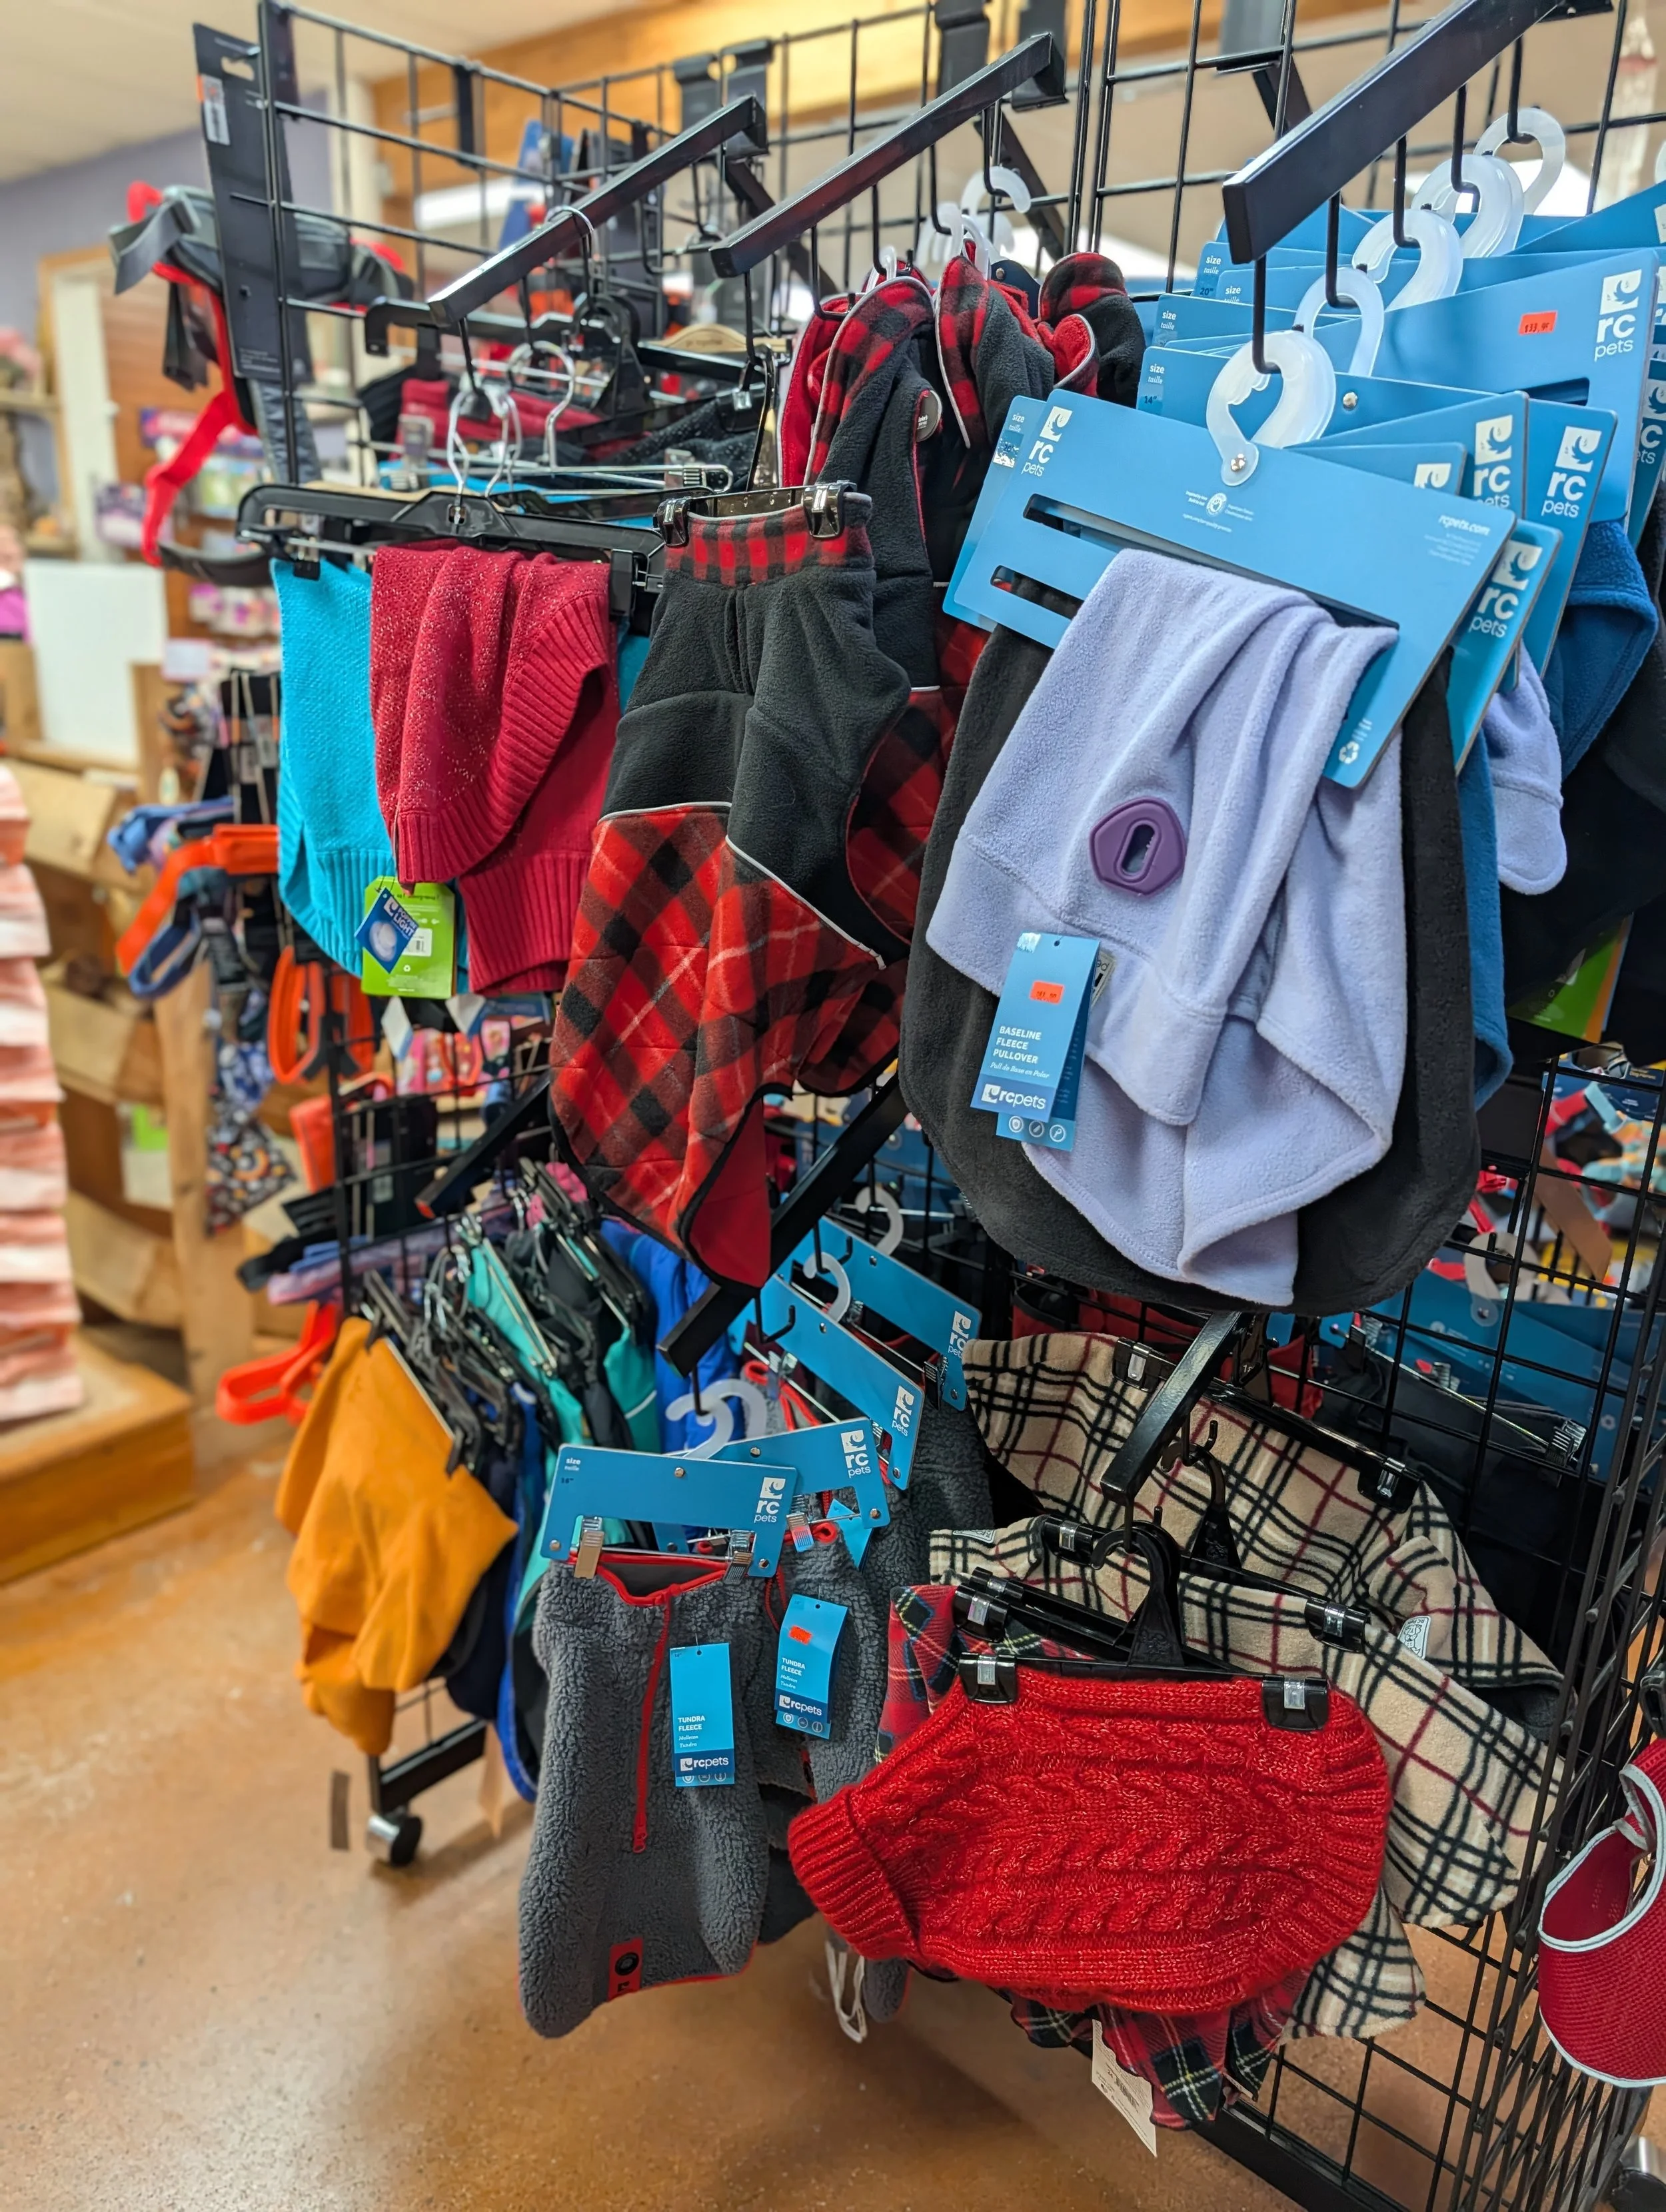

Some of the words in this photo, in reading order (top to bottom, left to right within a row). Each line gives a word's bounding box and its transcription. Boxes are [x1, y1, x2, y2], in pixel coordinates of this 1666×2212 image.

[1206, 255, 1222, 265] size
[1225, 285, 1241, 294] size
[1162, 310, 1177, 320] size
[1596, 314, 1637, 343] rc
[1593, 339, 1634, 362] pets
[1150, 364, 1166, 374] size
[1148, 375, 1163, 384] taille
[1144, 395, 1158, 404] 14"
[1012, 413, 1025, 423] size
[1640, 422, 1663, 449] c
[1028, 440, 1054, 464] rc
[1636, 448, 1656, 465] ets
[1021, 462, 1045, 477] pets
[1473, 465, 1511, 496] rc
[1547, 471, 1587, 502] rc
[1477, 494, 1510, 508] ets
[1541, 500, 1580, 518] pets
[1438, 515, 1491, 536] rcpets.com
[1477, 587, 1519, 620] rc
[1468, 616, 1508, 638] pets
[393, 913, 414, 937] LIGHT
[1000, 1026, 1042, 1040] BASELINE
[996, 1037, 1029, 1050] FLEECE
[992, 1048, 1038, 1065] PULLOVER
[1010, 1065, 1025, 1074] Base
[1033, 1070, 1050, 1079] Polar
[999, 1089, 1046, 1109] rcpets
[948, 1345, 962, 1359] pet
[893, 1406, 910, 1428] rc
[892, 1420, 908, 1436] pets
[845, 1453, 869, 1468] rc
[848, 1466, 871, 1478] pets
[756, 1500, 780, 1514] rc
[754, 1514, 777, 1524] pets
[781, 1665, 802, 1676] FLEECE
[782, 1658, 806, 1670] TUNDRA
[790, 1700, 822, 1716] rcpets
[694, 1756, 729, 1770] rcpets
